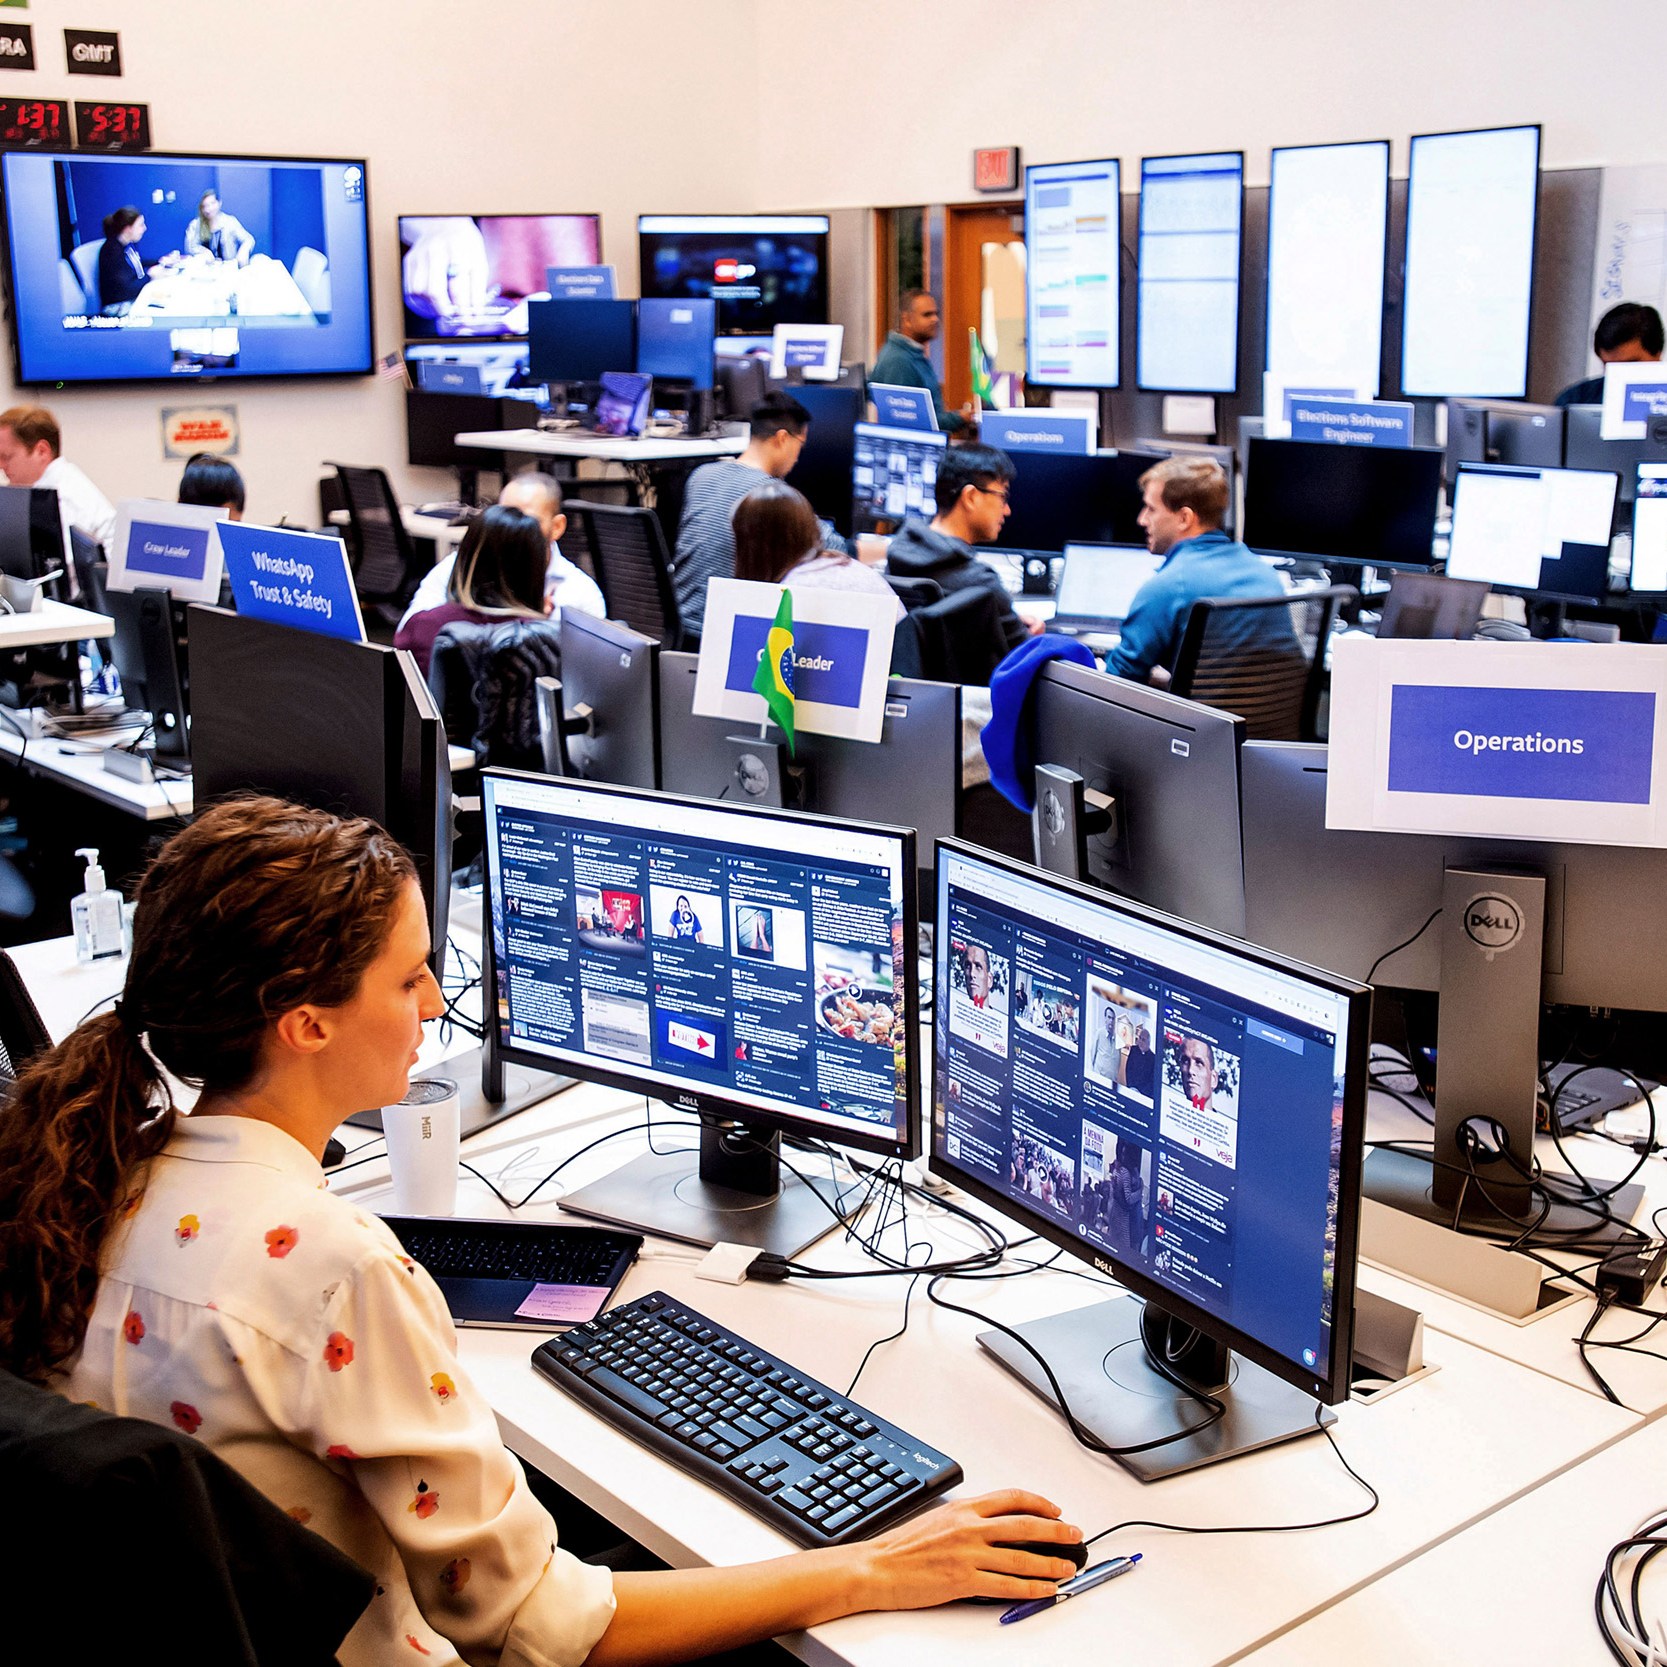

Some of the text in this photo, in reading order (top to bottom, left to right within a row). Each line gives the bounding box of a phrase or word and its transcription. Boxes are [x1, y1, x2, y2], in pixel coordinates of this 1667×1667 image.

[72, 43, 114, 63] GMT
[1296, 408, 1403, 430] Elections Software
[1004, 430, 1064, 445] Operations
[1322, 426, 1375, 445] Engineer
[165, 544, 191, 558] Leader
[251, 551, 314, 583] WhatsApp
[251, 581, 332, 619] Trust & Safety
[792, 653, 834, 671] Leader
[1453, 729, 1584, 756] Operations
[1470, 913, 1514, 930] DELL
[679, 1095, 699, 1107] DELL
[421, 1116, 432, 1140] MiiR
[1094, 1257, 1114, 1276] DELL
[913, 1452, 940, 1470] logitech
